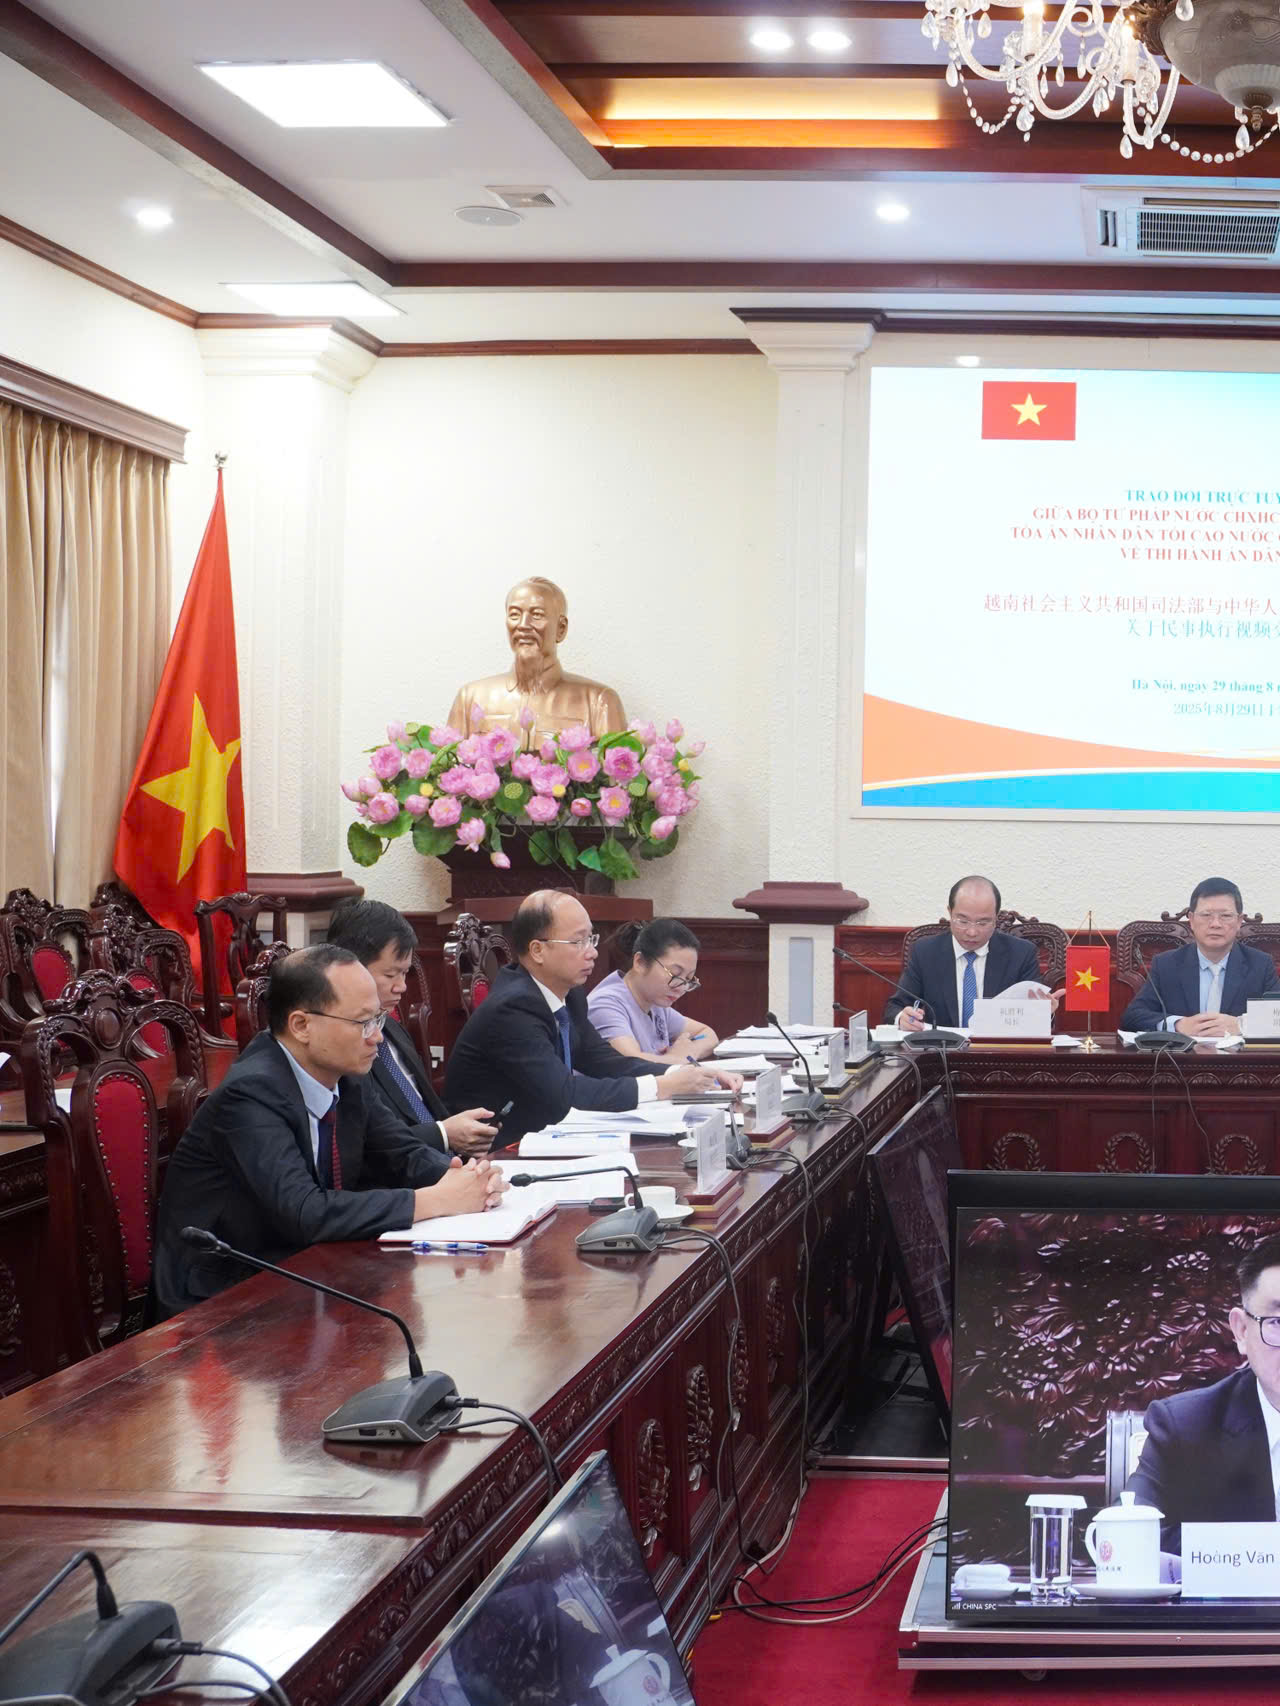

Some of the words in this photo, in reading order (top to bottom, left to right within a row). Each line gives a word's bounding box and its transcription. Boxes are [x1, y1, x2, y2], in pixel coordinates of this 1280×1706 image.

[1126, 490, 1169, 503] TRAO
[1190, 529, 1225, 543] CAO
[1146, 548, 1172, 561] THI
[1212, 680, 1226, 691] 29
[1266, 682, 1274, 692] 8
[1246, 1550, 1275, 1565] Văn
[962, 1602, 984, 1610] CHINA
[984, 1602, 997, 1611] SPC
